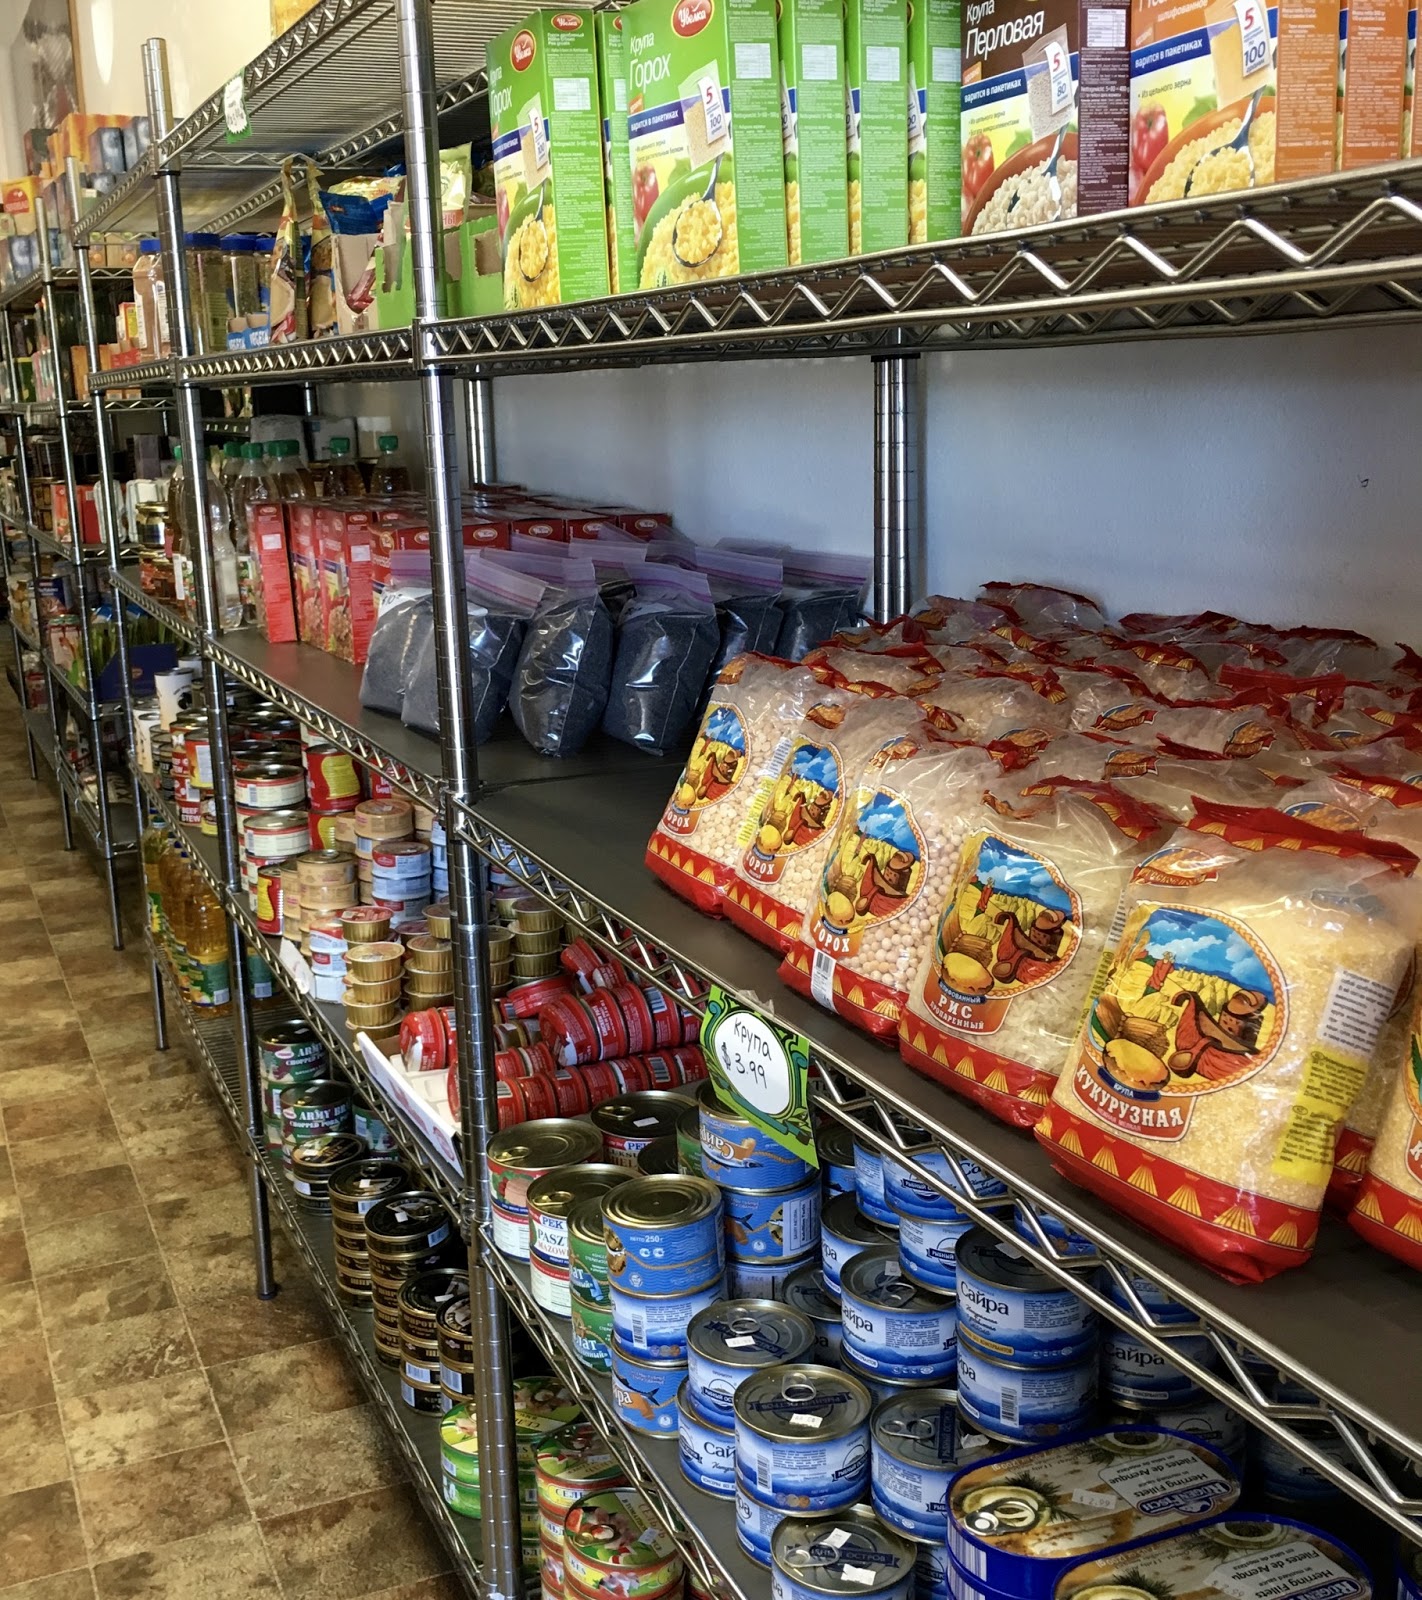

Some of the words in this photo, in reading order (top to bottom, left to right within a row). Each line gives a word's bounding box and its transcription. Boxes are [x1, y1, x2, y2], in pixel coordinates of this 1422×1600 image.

[966, 0, 995, 24] Крупа
[1244, 7, 1254, 30] 5
[630, 32, 655, 57] Крупа
[966, 11, 1044, 60] Перловая
[1052, 52, 1061, 72] 5
[1135, 53, 1160, 69] варится
[1160, 52, 1164, 60] в
[1164, 38, 1203, 57] пакетиках
[1244, 41, 1266, 67] 100
[629, 53, 672, 93] Горох
[706, 86, 713, 105] 5
[964, 87, 986, 104] варится
[986, 88, 990, 96] в
[990, 78, 1022, 95] пакетиках
[652, 109, 679, 126] пакетиках
[710, 114, 722, 129] 100
[181, 814, 201, 823] STEW
[182, 807, 199, 815] BEEF
[812, 920, 850, 952] ГОРОХ
[929, 1000, 985, 1030] ПРОПАРЕННЫЙ
[938, 994, 973, 1019] РИС
[1076, 1063, 1184, 1128] КУКУРУЗНАЯ
[1113, 1082, 1134, 1098] КРУПА
[299, 1109, 331, 1121] ARMY
[701, 1125, 735, 1161] Сайр
[542, 1216, 564, 1230] PEK
[537, 1229, 566, 1247] PASZ
[644, 1234, 661, 1243] 250
[538, 1242, 568, 1256] MAZOW
[960, 1280, 1009, 1317] Сайра
[575, 1338, 597, 1351] лат
[1102, 1342, 1165, 1367] Сайра
[703, 1441, 735, 1460] Сай
[1152, 1464, 1164, 1472] de
[1165, 1456, 1199, 1469] Filetes
[1108, 1470, 1151, 1485] Arenque
[1166, 1472, 1209, 1493] Herring
[555, 1487, 585, 1499] СЕЛЬ
[1133, 1484, 1166, 1499] Fillets
[846, 1551, 886, 1563] ОСТРОВ
[1270, 1560, 1284, 1570] de
[1285, 1550, 1320, 1564] Filetes
[1231, 1564, 1271, 1582] Arenqu
[1290, 1569, 1334, 1588] Herring
[1254, 1583, 1290, 1599] Fillets
